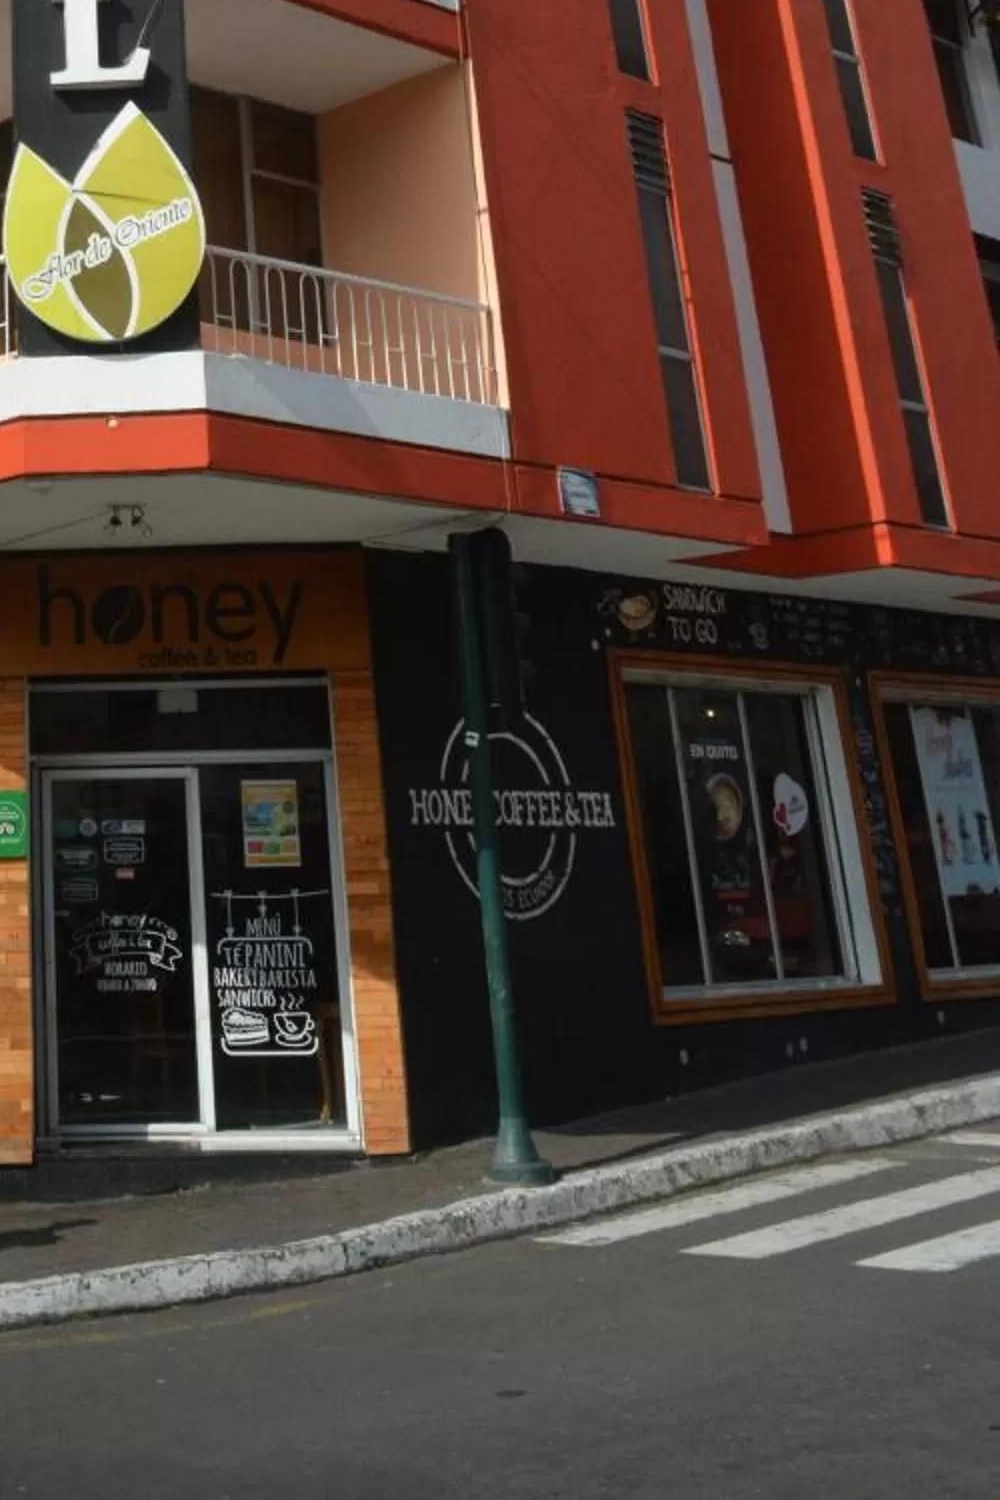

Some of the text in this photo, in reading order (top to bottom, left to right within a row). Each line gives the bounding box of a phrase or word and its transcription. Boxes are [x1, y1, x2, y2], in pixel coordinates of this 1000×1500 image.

[86, 235, 111, 267] de
[37, 564, 302, 664] honey
[667, 615, 717, 644] TO GO
[136, 646, 257, 669] coffee & tea
[408, 787, 475, 826] HONE
[245, 943, 306, 968] PANINI
[259, 968, 318, 988] BARISTA
